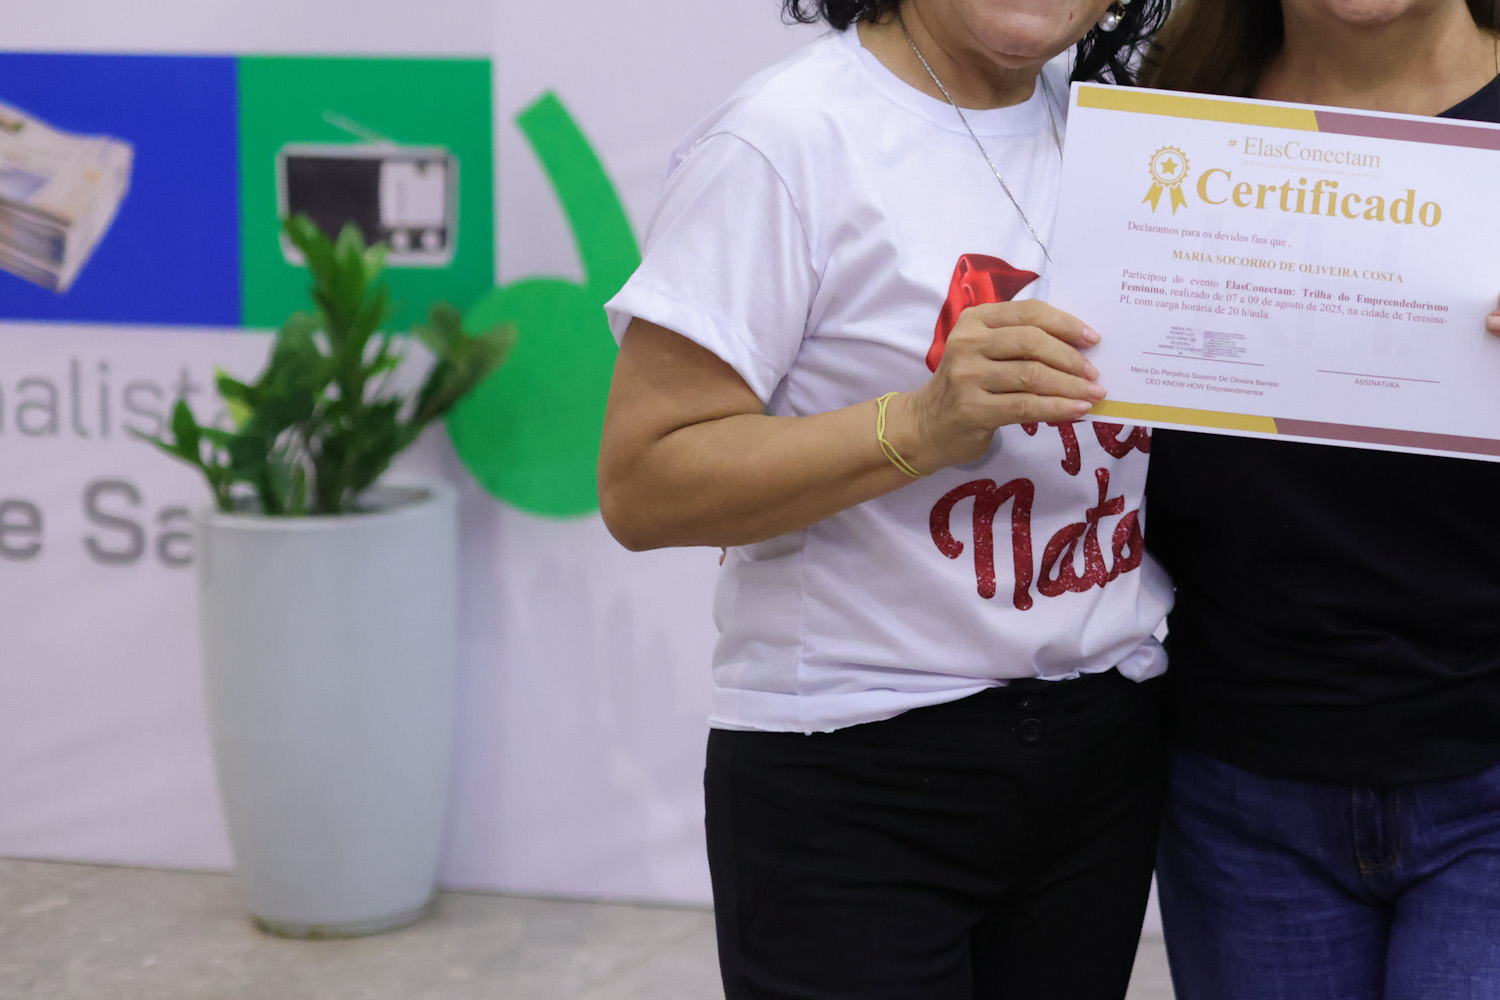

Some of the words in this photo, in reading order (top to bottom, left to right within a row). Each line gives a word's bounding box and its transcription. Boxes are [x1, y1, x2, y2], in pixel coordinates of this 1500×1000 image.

[1244, 136, 1380, 168] ElasConectam
[1196, 167, 1442, 228] Certificado
[1128, 221, 1179, 236] Declaramos
[1181, 228, 1200, 238] para
[1202, 231, 1212, 239] os
[1214, 230, 1249, 242] devidos
[1251, 234, 1268, 245] fins
[1172, 249, 1213, 264] MARIA
[1215, 254, 1276, 270] SOCORRO
[1279, 260, 1296, 272] DE
[1298, 263, 1359, 278] OLIVEIRA
[1362, 270, 1404, 284] COSTA
[1121, 282, 1168, 296] Feminino,
[1170, 288, 1210, 300] realizado
[1212, 292, 1224, 302] de
[1226, 292, 1237, 302] 07
[1240, 296, 1246, 304] a
[1248, 294, 1259, 304] 09
[1262, 296, 1272, 306] de
[1275, 300, 1304, 310] agosto
[1306, 302, 1318, 311] de
[1320, 302, 1344, 315] 2025,
[1347, 308, 1358, 316] na
[1360, 308, 1390, 319] cidade
[1392, 311, 1404, 320] de
[1406, 312, 1448, 325] Teresina-
[1122, 268, 1168, 284] Participou
[1172, 274, 1184, 284] do
[1190, 278, 1220, 288] evento
[1225, 280, 1296, 296] ElasConectam:
[1302, 288, 1332, 300] Trilha
[1338, 292, 1350, 302] do
[1356, 294, 1449, 312] Empreendedorismo
[1120, 294, 1132, 305] PI,
[1134, 298, 1153, 306] com
[1155, 300, 1179, 310] carga
[1181, 303, 1212, 314] horária
[1214, 305, 1226, 314] de
[1228, 306, 1239, 316] 20
[1130, 365, 1149, 374] Maria
[1162, 369, 1190, 380] Perpétuo
[1192, 372, 1217, 382] Socorro
[1230, 376, 1254, 386] Oliveira
[1256, 380, 1280, 388] Barreto
[1145, 378, 1161, 386] CEO
[1162, 380, 1205, 390] KNOW-HOW
[1206, 384, 1264, 396] Empreendimentos
[1354, 378, 1400, 389] ASSINATURA
